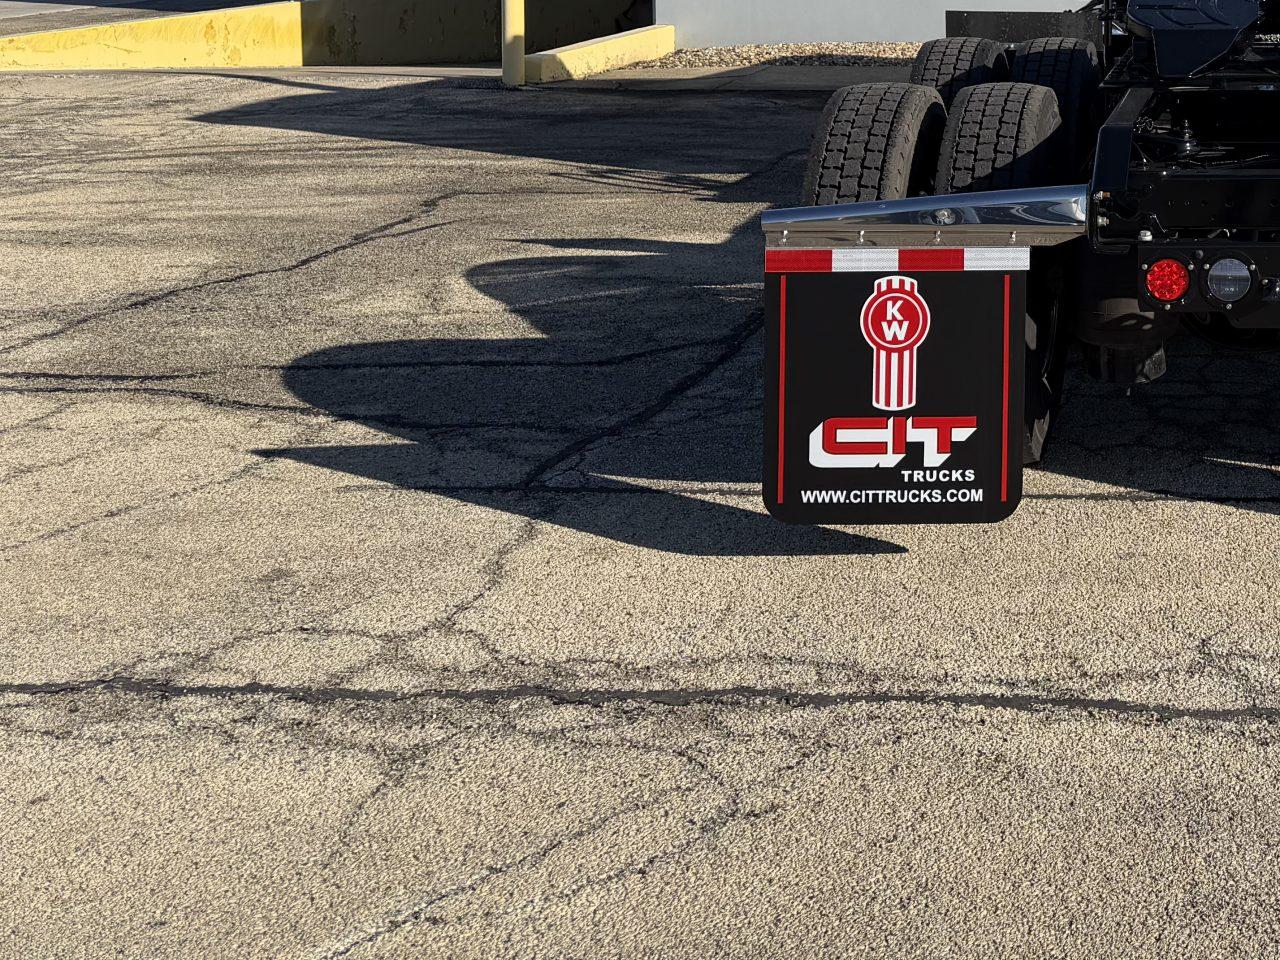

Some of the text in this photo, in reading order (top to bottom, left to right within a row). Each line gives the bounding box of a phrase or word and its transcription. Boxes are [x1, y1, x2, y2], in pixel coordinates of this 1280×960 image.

[813, 415, 978, 462] CIT
[901, 469, 976, 483] TRUCKS
[801, 488, 984, 504] WWW.CITTRUCKS.COM
